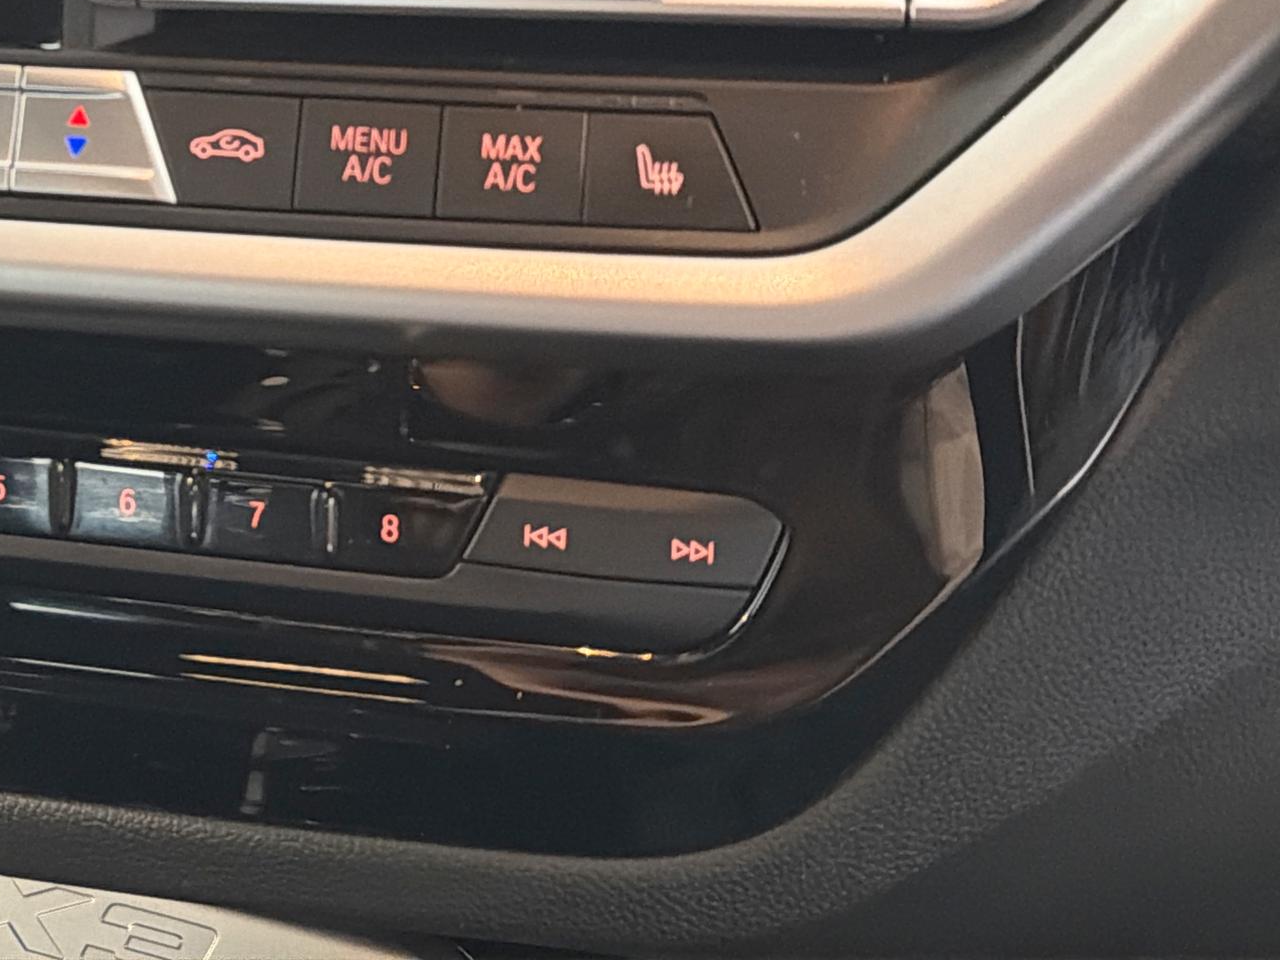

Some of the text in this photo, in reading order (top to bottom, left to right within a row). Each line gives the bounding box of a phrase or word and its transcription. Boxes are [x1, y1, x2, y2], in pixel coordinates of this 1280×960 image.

[330, 125, 409, 155] MENU
[480, 132, 543, 162] MAX
[341, 156, 393, 186] A/C
[483, 161, 537, 194] A/C
[119, 488, 137, 516] 6
[249, 499, 267, 529] 7
[380, 514, 400, 544] 8
